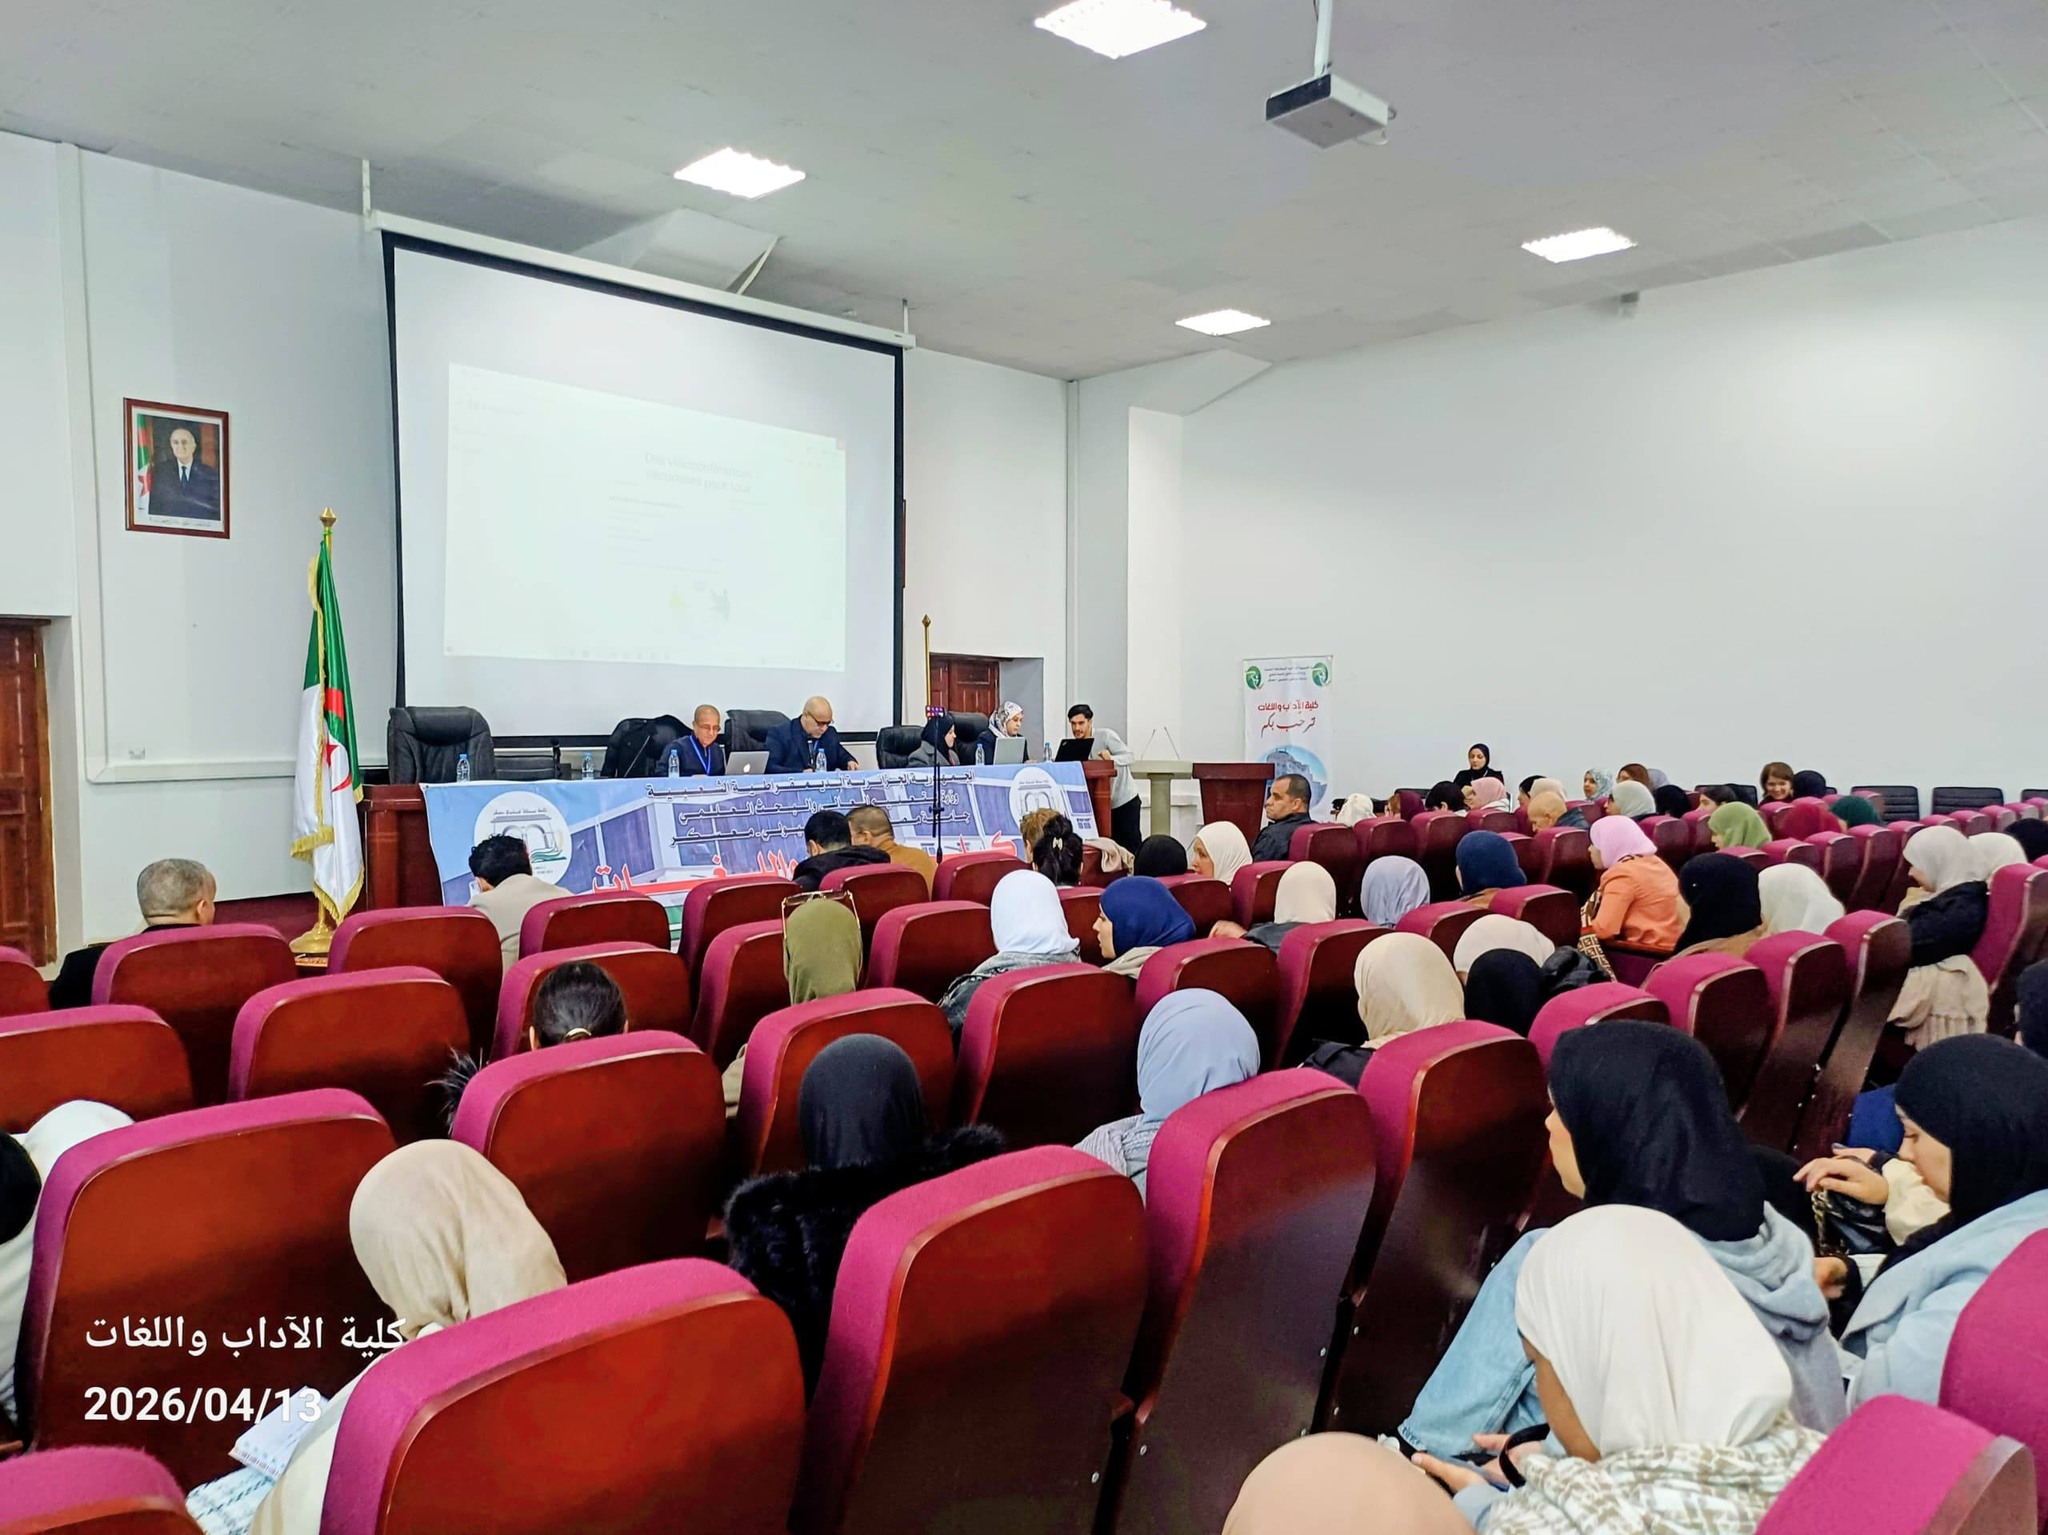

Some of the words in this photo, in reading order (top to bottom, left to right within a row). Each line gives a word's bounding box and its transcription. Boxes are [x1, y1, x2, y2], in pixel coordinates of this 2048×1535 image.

[911, 770, 974, 786] الجمهرية
[646, 779, 731, 801] الشعبية
[679, 804, 755, 824] العلمي
[755, 798, 817, 816] والبحث
[670, 827, 755, 847] معسكر
